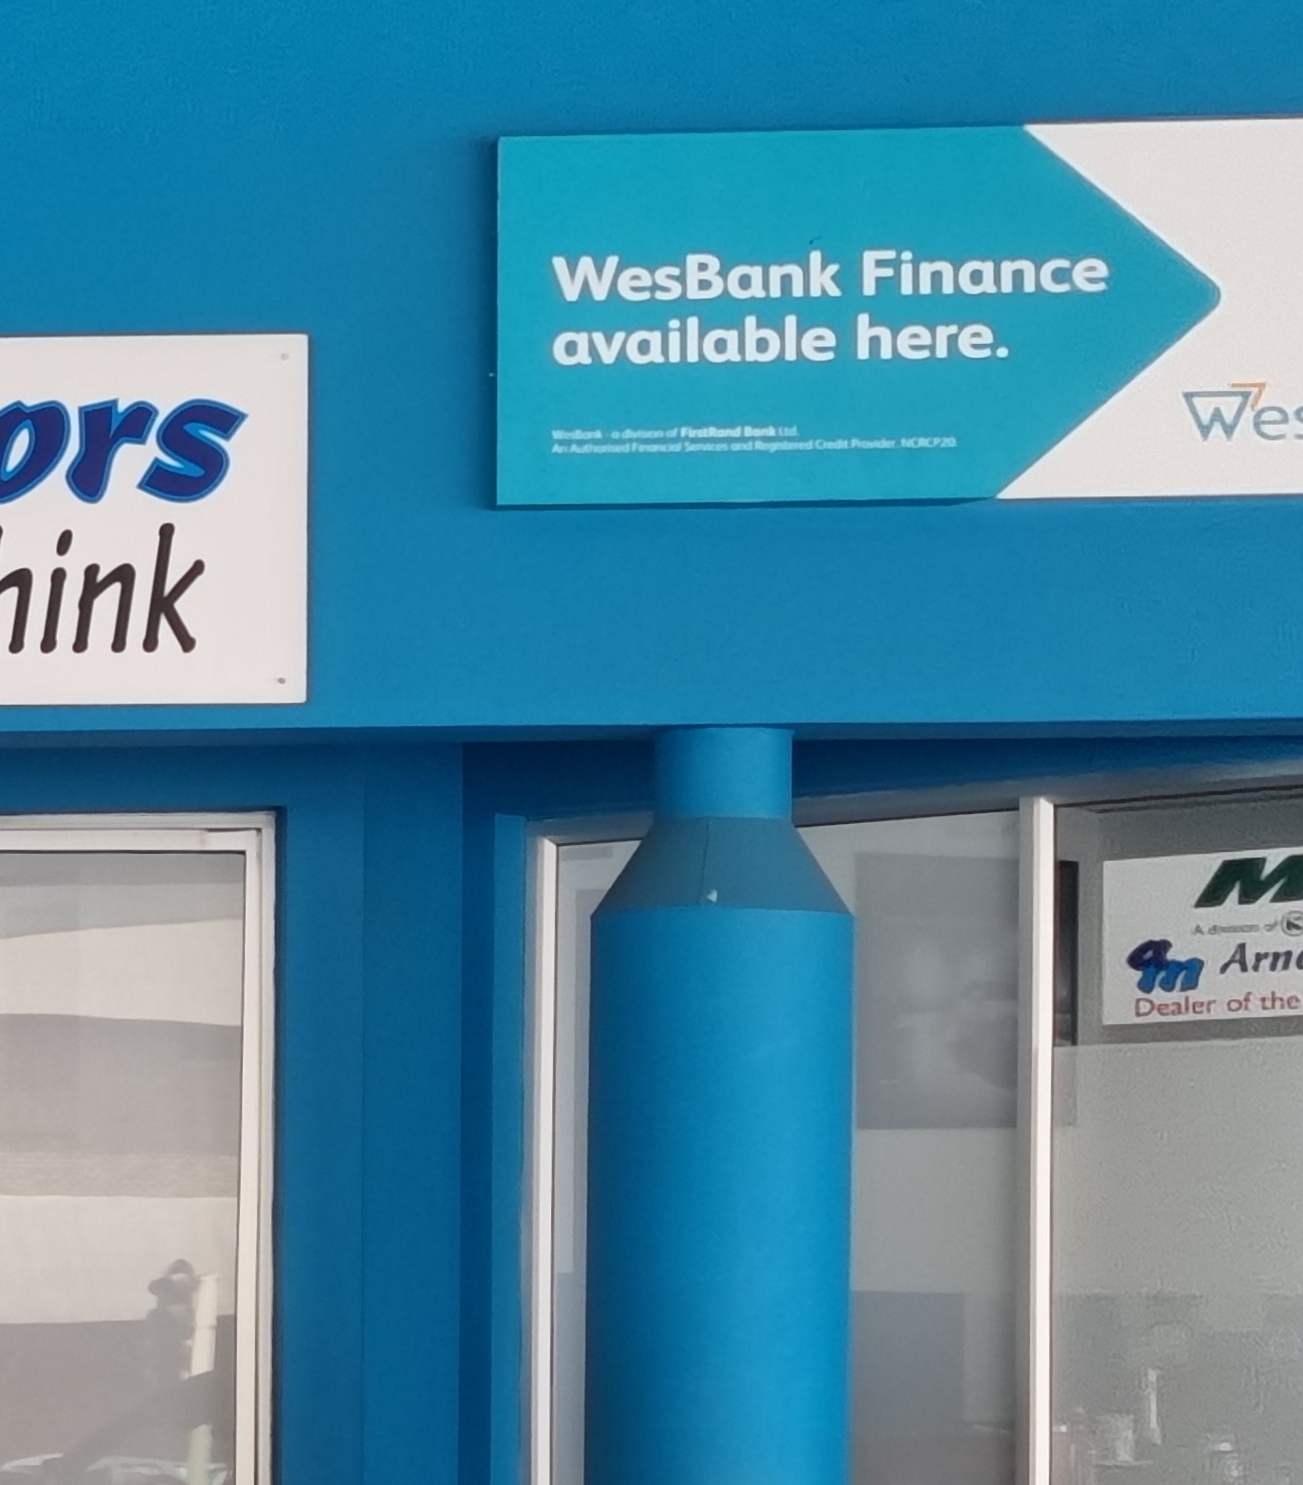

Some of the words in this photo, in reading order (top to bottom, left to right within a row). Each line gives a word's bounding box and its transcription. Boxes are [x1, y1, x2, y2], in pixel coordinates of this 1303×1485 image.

[552, 250, 842, 302] WesBank
[861, 247, 1110, 297] Finance
[551, 315, 836, 366] available
[855, 313, 1010, 361] here.
[680, 426, 741, 438] FirstRand
[743, 425, 776, 437] Bank
[1134, 995, 1217, 1018] Dealer
[1226, 991, 1253, 1012] of
[1260, 990, 1299, 1011] the
